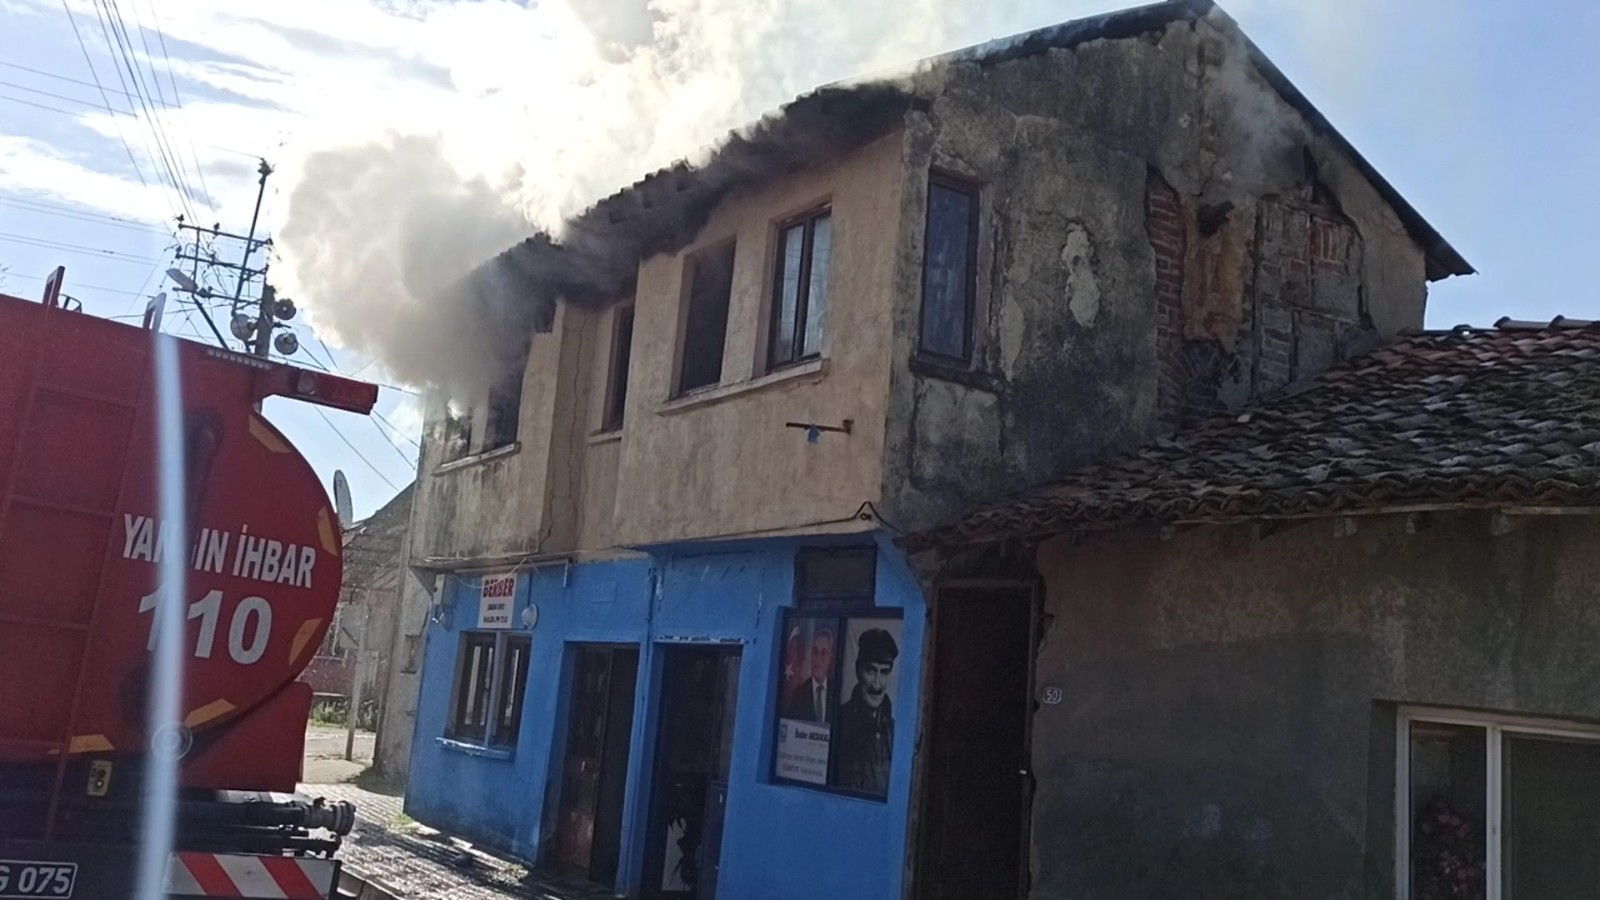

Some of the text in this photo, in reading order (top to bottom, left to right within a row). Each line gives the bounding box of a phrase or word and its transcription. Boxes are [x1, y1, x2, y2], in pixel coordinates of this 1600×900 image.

[123, 513, 316, 588] YANIN İHBAR
[138, 580, 273, 665] 110
[1046, 689, 1058, 702] 50
[18, 866, 72, 893] 075
